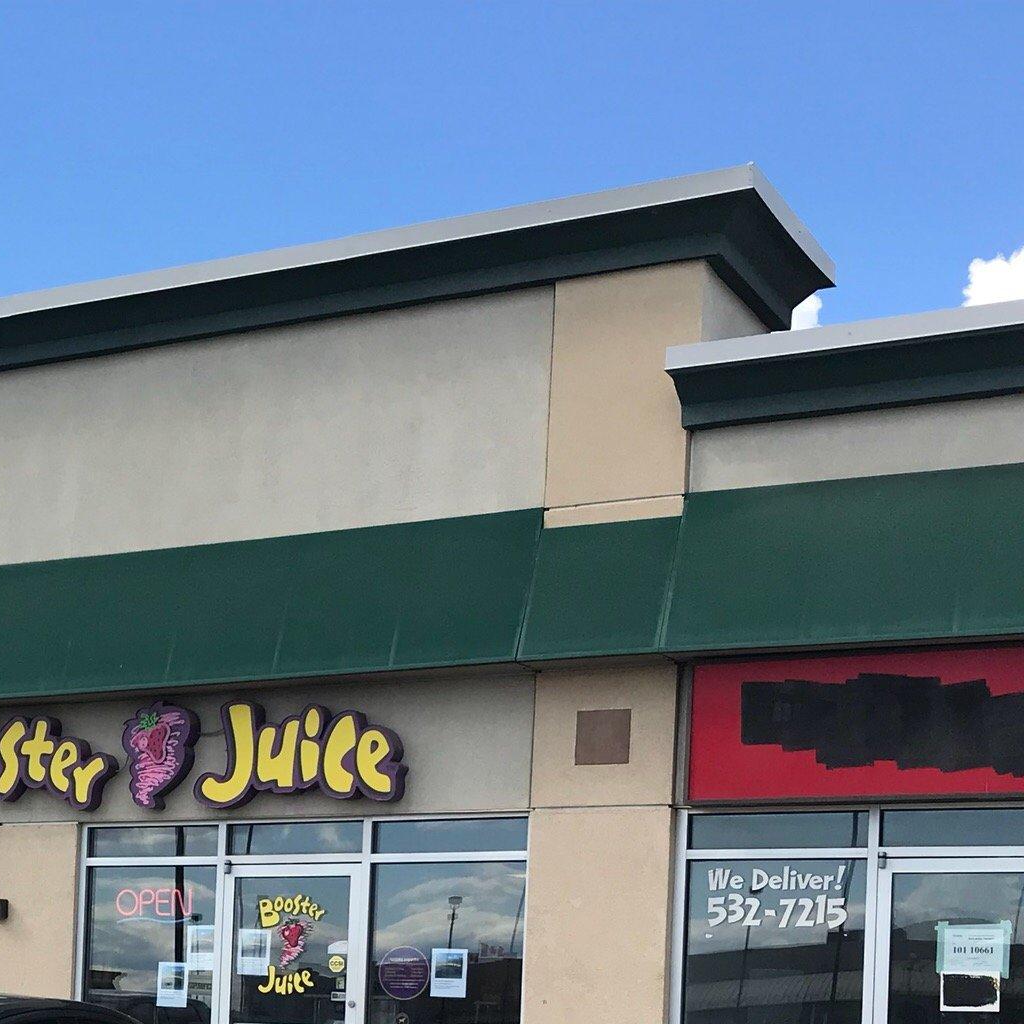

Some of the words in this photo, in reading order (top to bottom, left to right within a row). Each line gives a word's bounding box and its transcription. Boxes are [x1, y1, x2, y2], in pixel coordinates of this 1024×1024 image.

[201, 703, 391, 802] Juice
[708, 868, 744, 891] We
[751, 865, 846, 891] Deliver!
[115, 887, 194, 917] OPEN
[259, 894, 324, 927] Booster
[707, 893, 848, 929] 532-7215
[953, 946, 967, 954] 101
[970, 946, 994, 954] 10661
[257, 965, 314, 995] Juice
